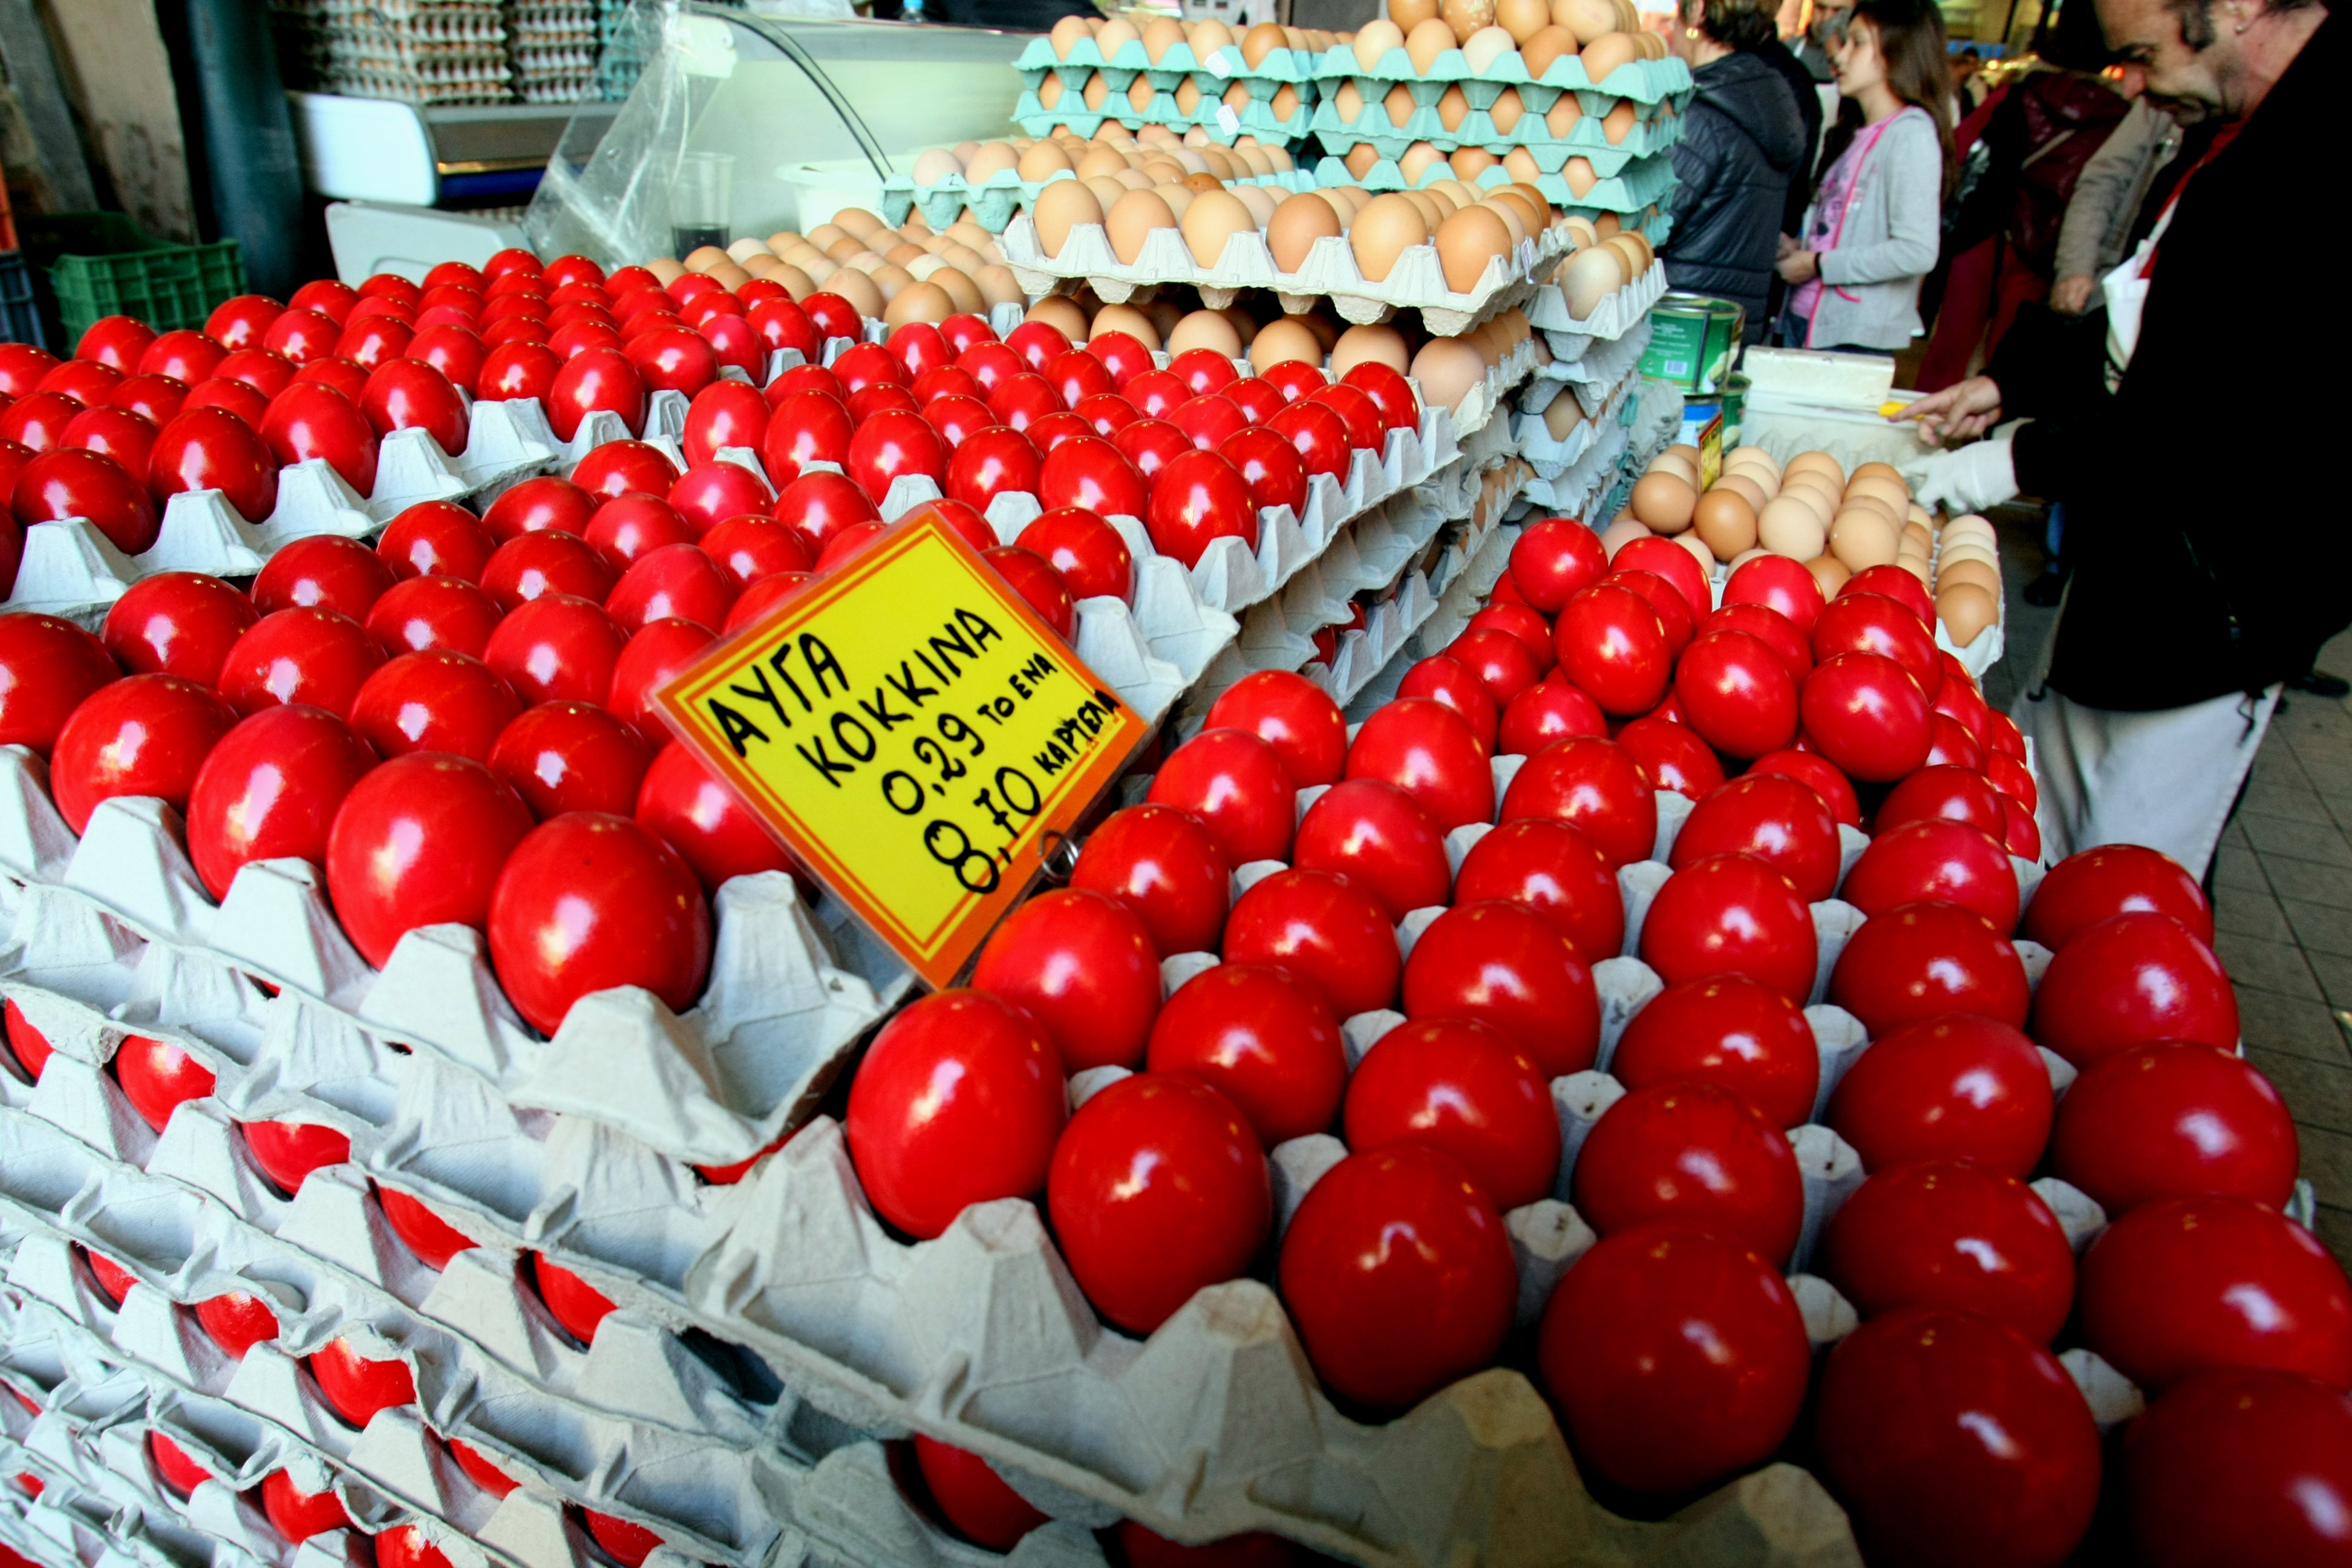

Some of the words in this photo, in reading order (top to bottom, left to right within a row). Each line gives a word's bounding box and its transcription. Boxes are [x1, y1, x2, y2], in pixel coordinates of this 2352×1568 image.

[707, 633, 849, 757] ΑΥΓΑ
[796, 607, 1002, 788] ΚΟΚΚΙΝΑ
[881, 713, 985, 815] 0,29
